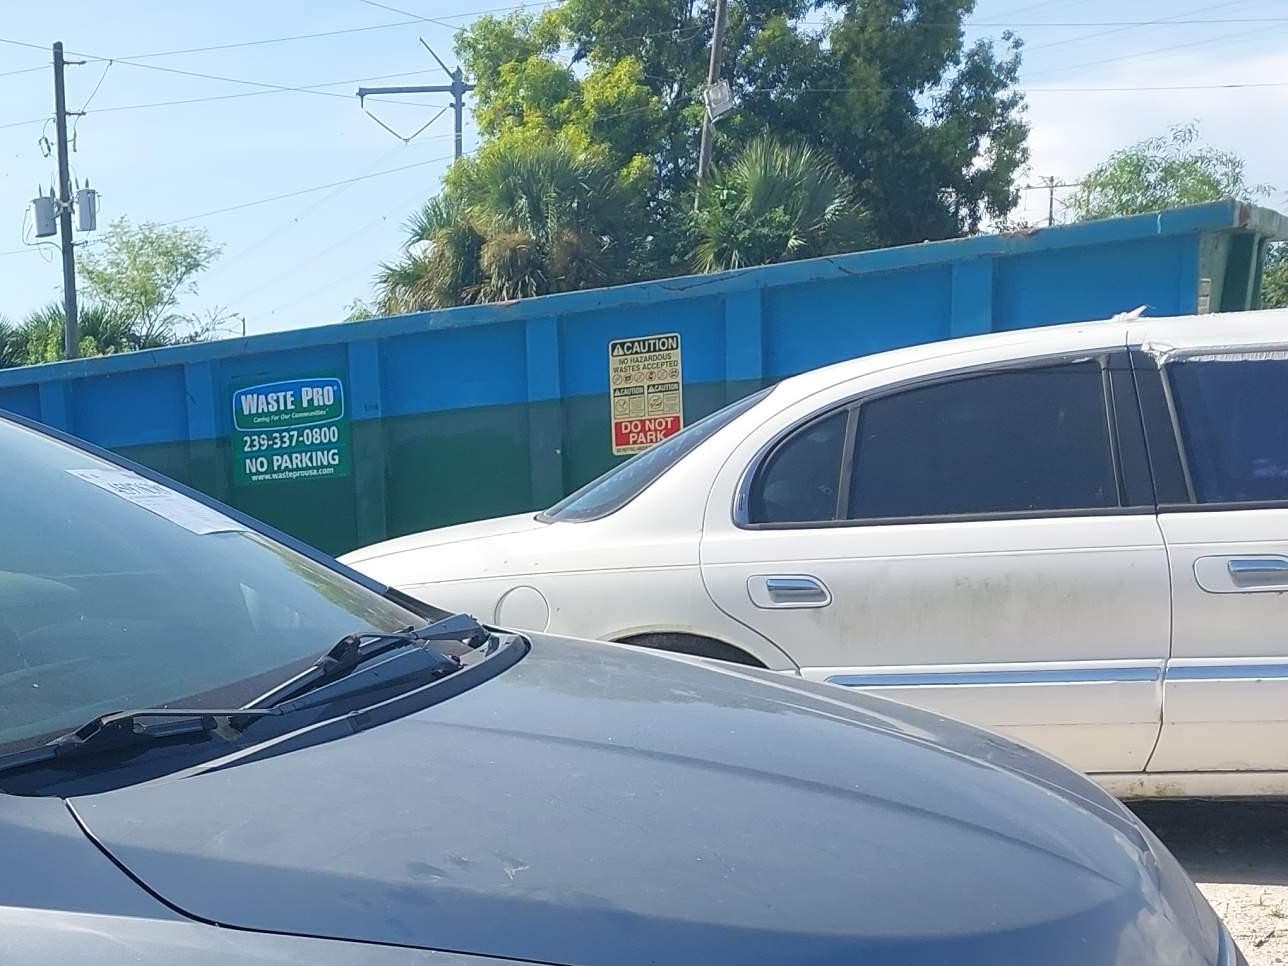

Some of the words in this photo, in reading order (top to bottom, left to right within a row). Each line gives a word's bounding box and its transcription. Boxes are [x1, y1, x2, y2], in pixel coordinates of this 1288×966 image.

[623, 337, 677, 354] CAUTION
[630, 353, 672, 363] HAZARDOUS
[613, 365, 640, 373] WASTES
[642, 360, 678, 370] ACCEPTED
[622, 421, 641, 433] DO
[645, 418, 673, 432] NOT
[243, 426, 338, 452] 239-337-0800
[629, 430, 665, 444] PARK
[245, 458, 268, 474] NO
[273, 449, 339, 471] PARKING
[251, 467, 334, 481] www.wasteprousa.com
